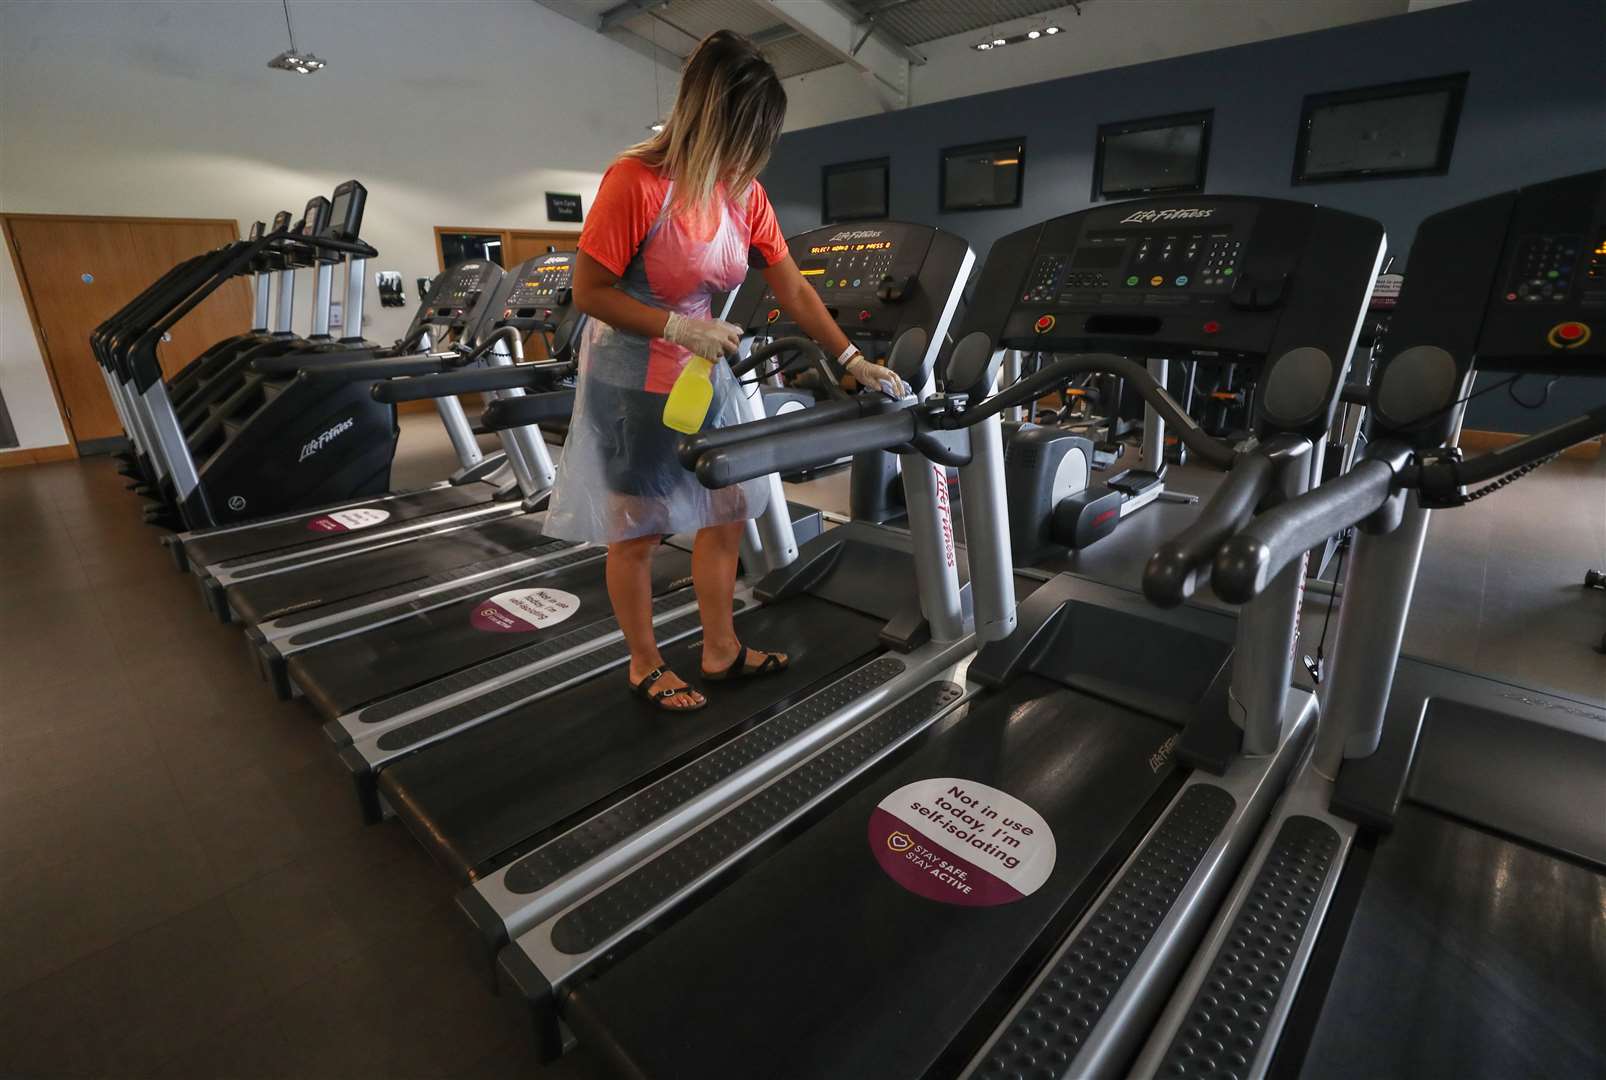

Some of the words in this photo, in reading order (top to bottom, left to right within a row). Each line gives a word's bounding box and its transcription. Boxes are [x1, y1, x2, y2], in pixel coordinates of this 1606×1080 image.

[911, 801, 1021, 869] self-isolating
[935, 797, 985, 832] today,
[992, 828, 1021, 848] I'm
[947, 785, 979, 809] Not
[981, 805, 998, 820] in
[1002, 817, 1034, 836] use
[905, 851, 933, 870] STAY
[930, 869, 973, 895] ACTIVE
[914, 844, 941, 863] STAY
[938, 860, 969, 881] SAFE,
